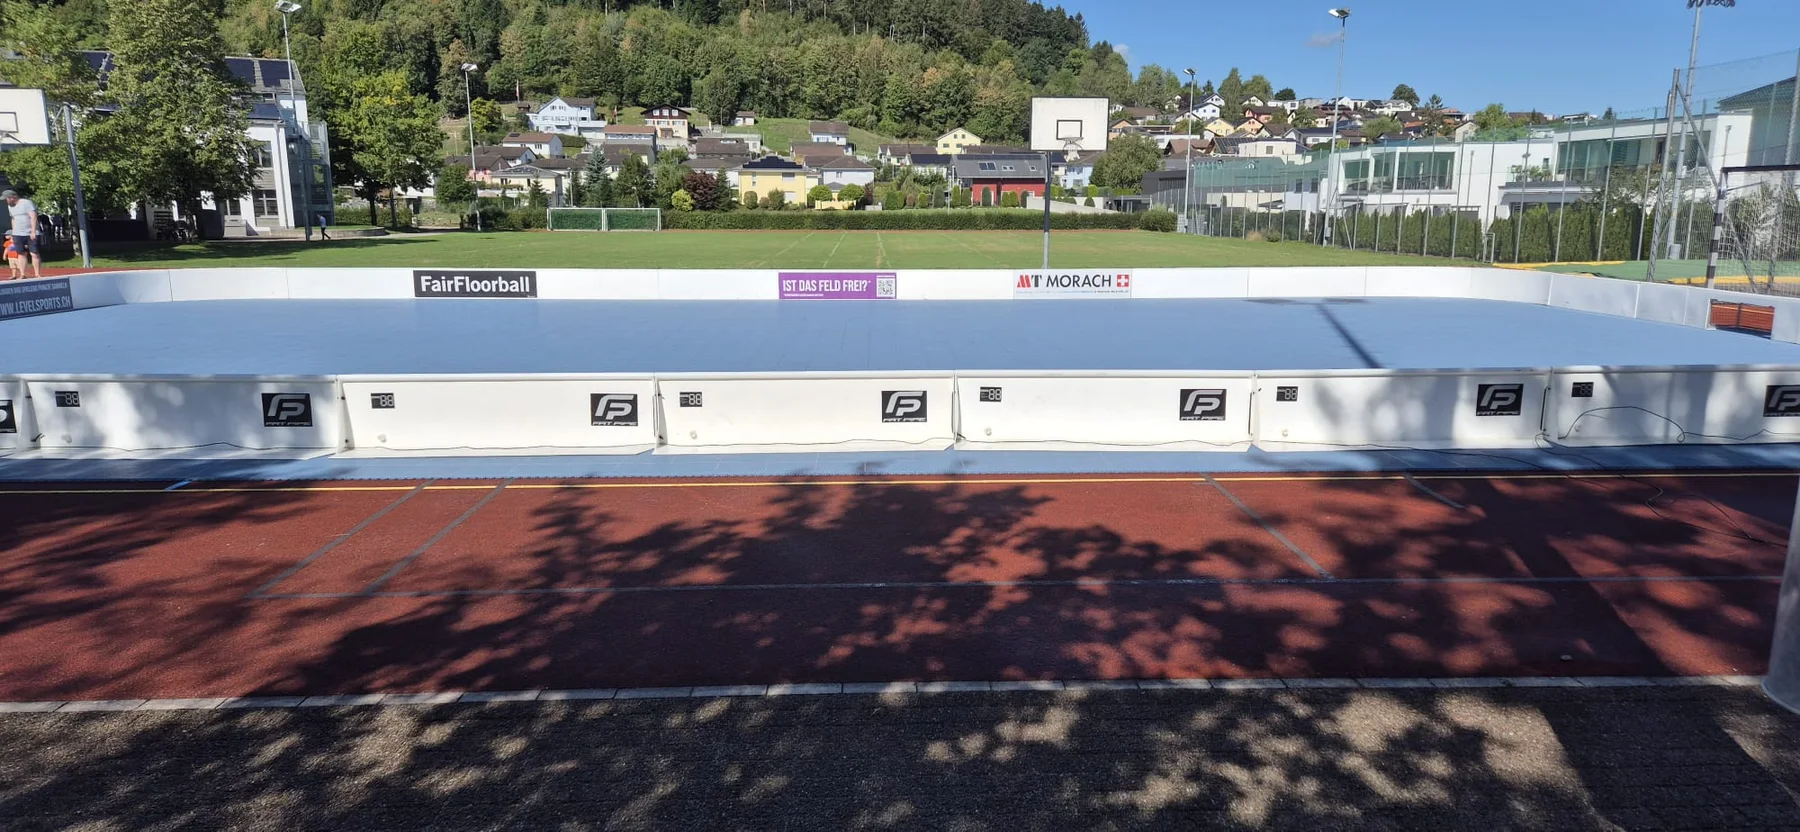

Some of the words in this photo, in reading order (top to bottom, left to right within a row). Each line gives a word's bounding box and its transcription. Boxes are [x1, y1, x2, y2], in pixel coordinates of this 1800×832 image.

[421, 275, 530, 293] FairFloorball
[783, 279, 797, 292] IST
[799, 279, 817, 292] DAS
[819, 279, 841, 292] FELD
[1046, 274, 1112, 288] MORACH
[0, 295, 71, 316] WW.LEVELSPORTS.CH
